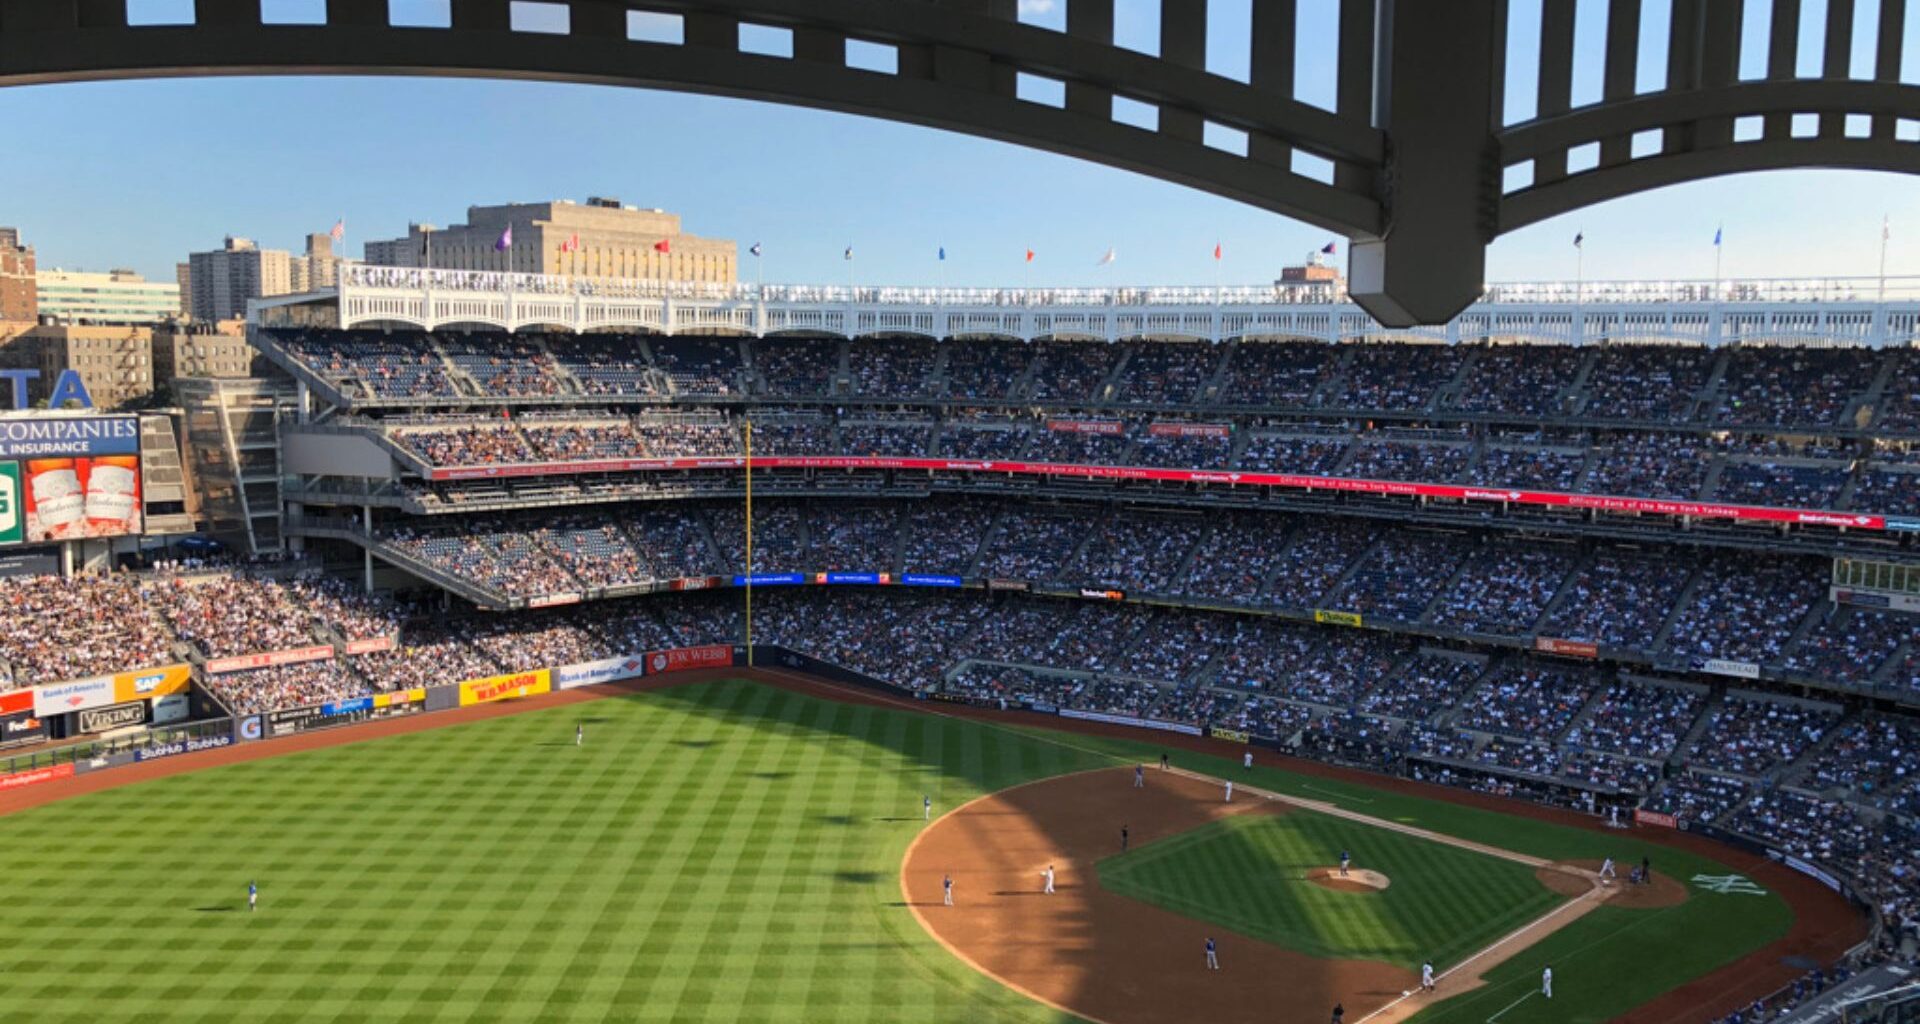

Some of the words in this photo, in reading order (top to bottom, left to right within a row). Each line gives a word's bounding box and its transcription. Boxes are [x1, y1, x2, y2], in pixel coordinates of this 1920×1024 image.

[11, 441, 89, 454] INSURANCE
[1605, 499, 1624, 507] Bank
[1680, 504, 1698, 512] York
[692, 648, 726, 660] WEBB
[560, 674, 580, 682] Bank
[590, 668, 621, 678] America
[43, 690, 62, 698] Bank
[74, 682, 106, 692] America
[135, 679, 159, 692] SAP
[83, 707, 140, 727] VIKING
[9, 719, 41, 732] FedEx
[141, 744, 183, 759] StubHub
[186, 737, 230, 752] StubHub
